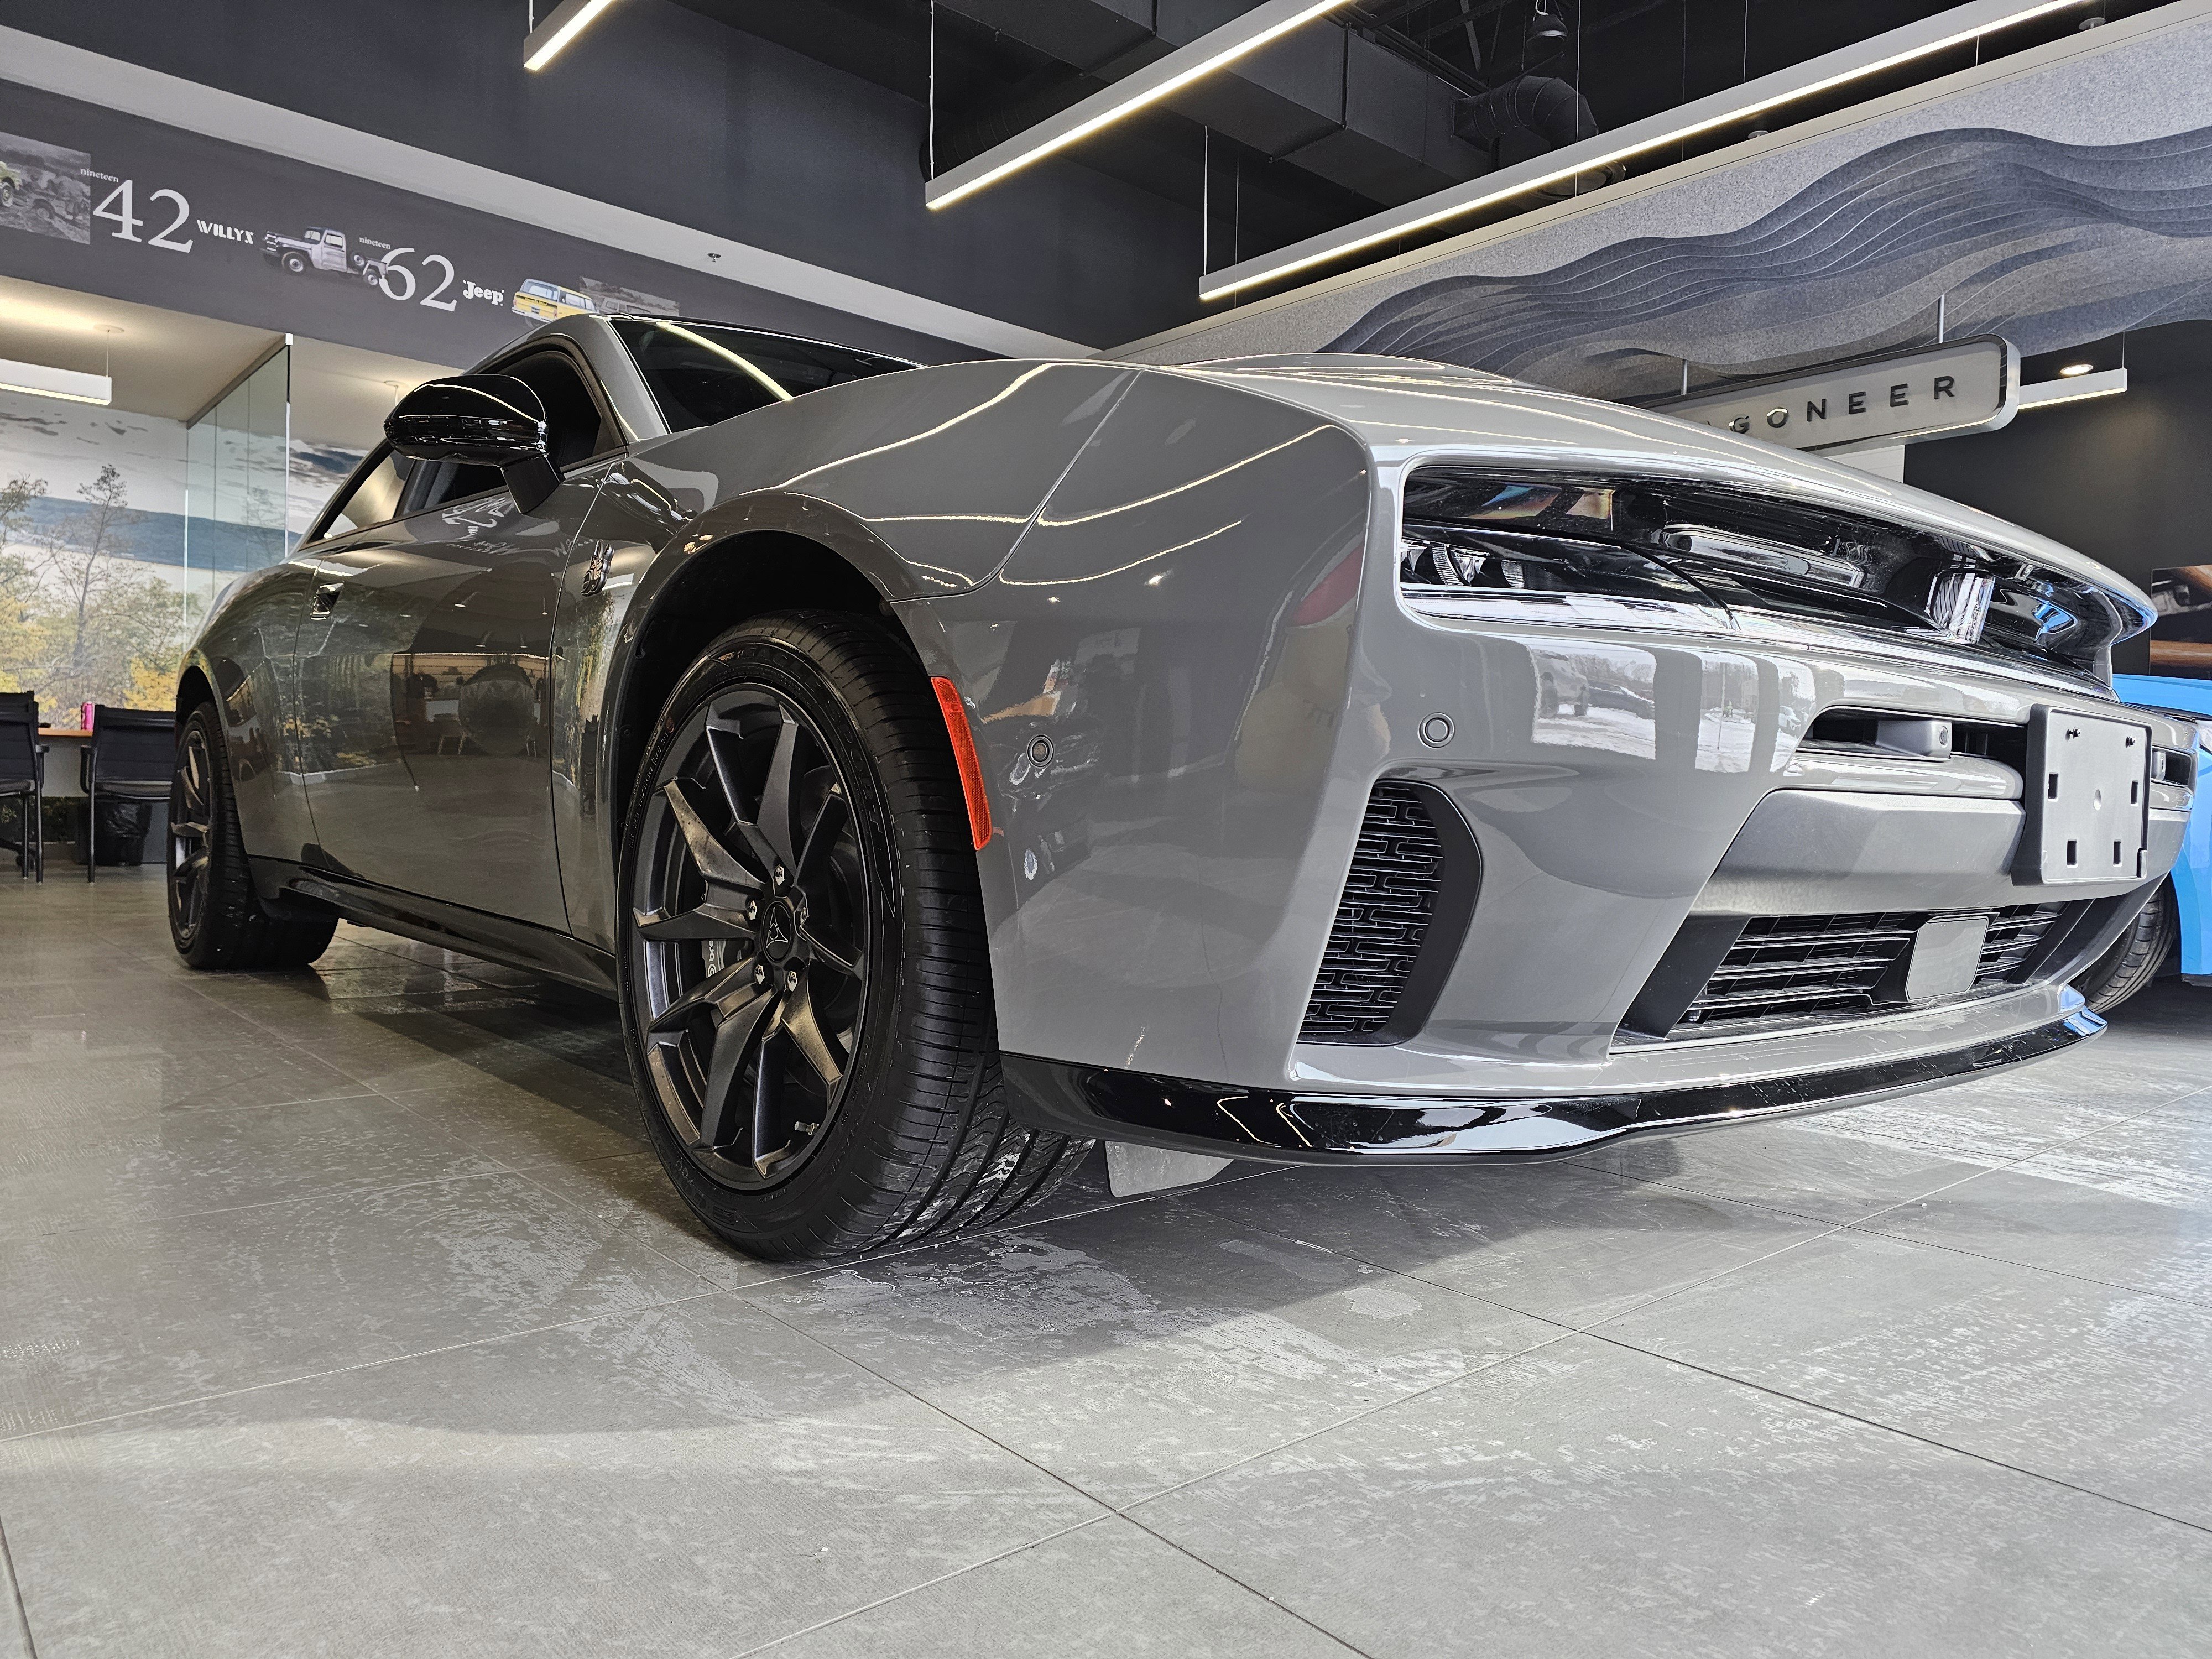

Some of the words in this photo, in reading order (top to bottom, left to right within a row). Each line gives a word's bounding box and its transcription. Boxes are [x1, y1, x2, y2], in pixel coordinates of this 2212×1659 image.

[80, 168, 119, 183] nineteen
[93, 180, 194, 253] 42
[197, 219, 254, 244] WILLYS
[359, 237, 391, 250] nineteen
[378, 247, 457, 312] 62
[1707, 375, 1955, 434] GONEER
